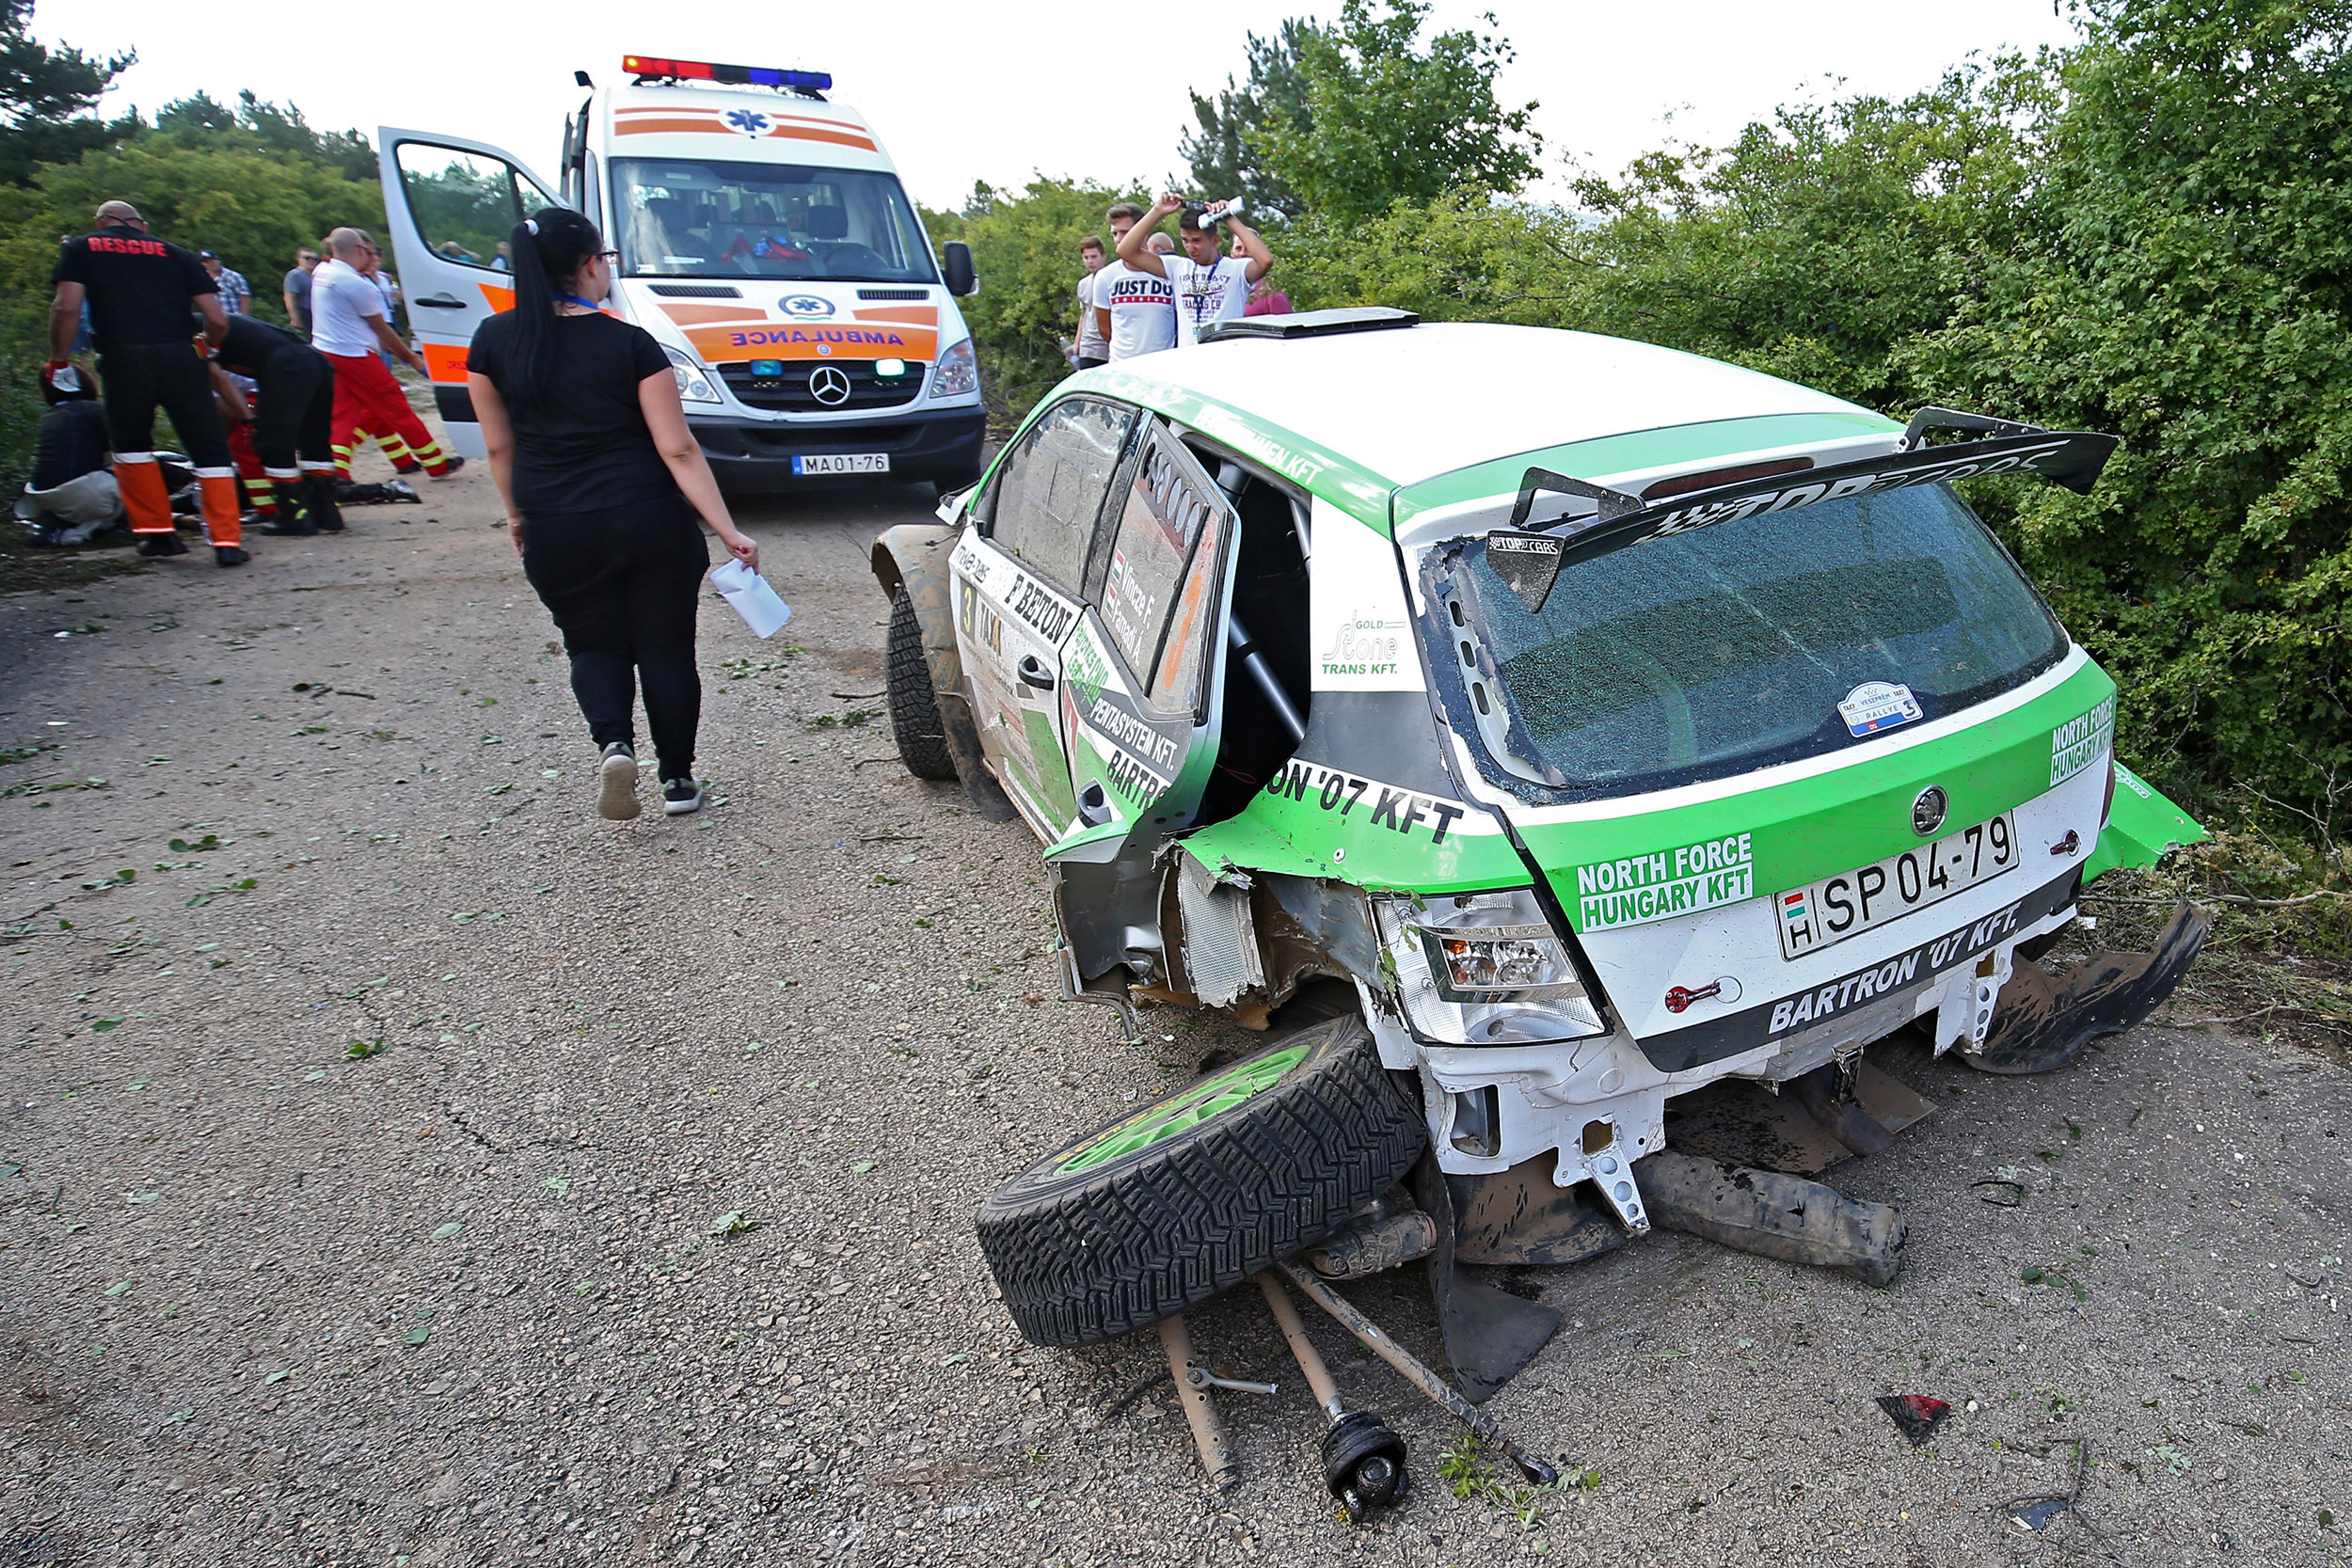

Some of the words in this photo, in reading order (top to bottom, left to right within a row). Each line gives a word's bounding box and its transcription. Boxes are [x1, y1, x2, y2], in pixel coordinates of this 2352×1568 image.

[87, 237, 167, 257] RESCUE
[1110, 279, 1148, 296] JUST
[963, 586, 972, 632] 3
[1004, 574, 1025, 604] F
[1120, 562, 1147, 618] Vincze
[1014, 581, 1073, 644] BETON
[1112, 601, 1137, 649] Farnadi
[1356, 620, 1383, 629] GOLD
[1322, 664, 1366, 674] TRANS
[1371, 664, 1398, 674] KFT.
[1860, 692, 1891, 706] VESZPRÉM
[1866, 705, 1899, 720] RALLYE
[1902, 700, 1916, 717] 3
[1089, 697, 1157, 760] PENTASYSTEM
[1151, 736, 1179, 772] KFT.
[2052, 713, 2089, 753] NORTH
[2090, 695, 2113, 733] FORCE
[2051, 736, 2098, 783] HUNGARY
[1318, 770, 1368, 816] '07
[1371, 787, 1465, 845] KFT
[1577, 852, 1667, 895] NORTH
[1675, 832, 1753, 877] FORCE
[1584, 879, 1700, 927] HUNGARY
[1708, 867, 1749, 903] KFT
[1789, 920, 1812, 949] H
[1769, 950, 1922, 1035] BARTRON
[1928, 932, 1963, 969] '07
